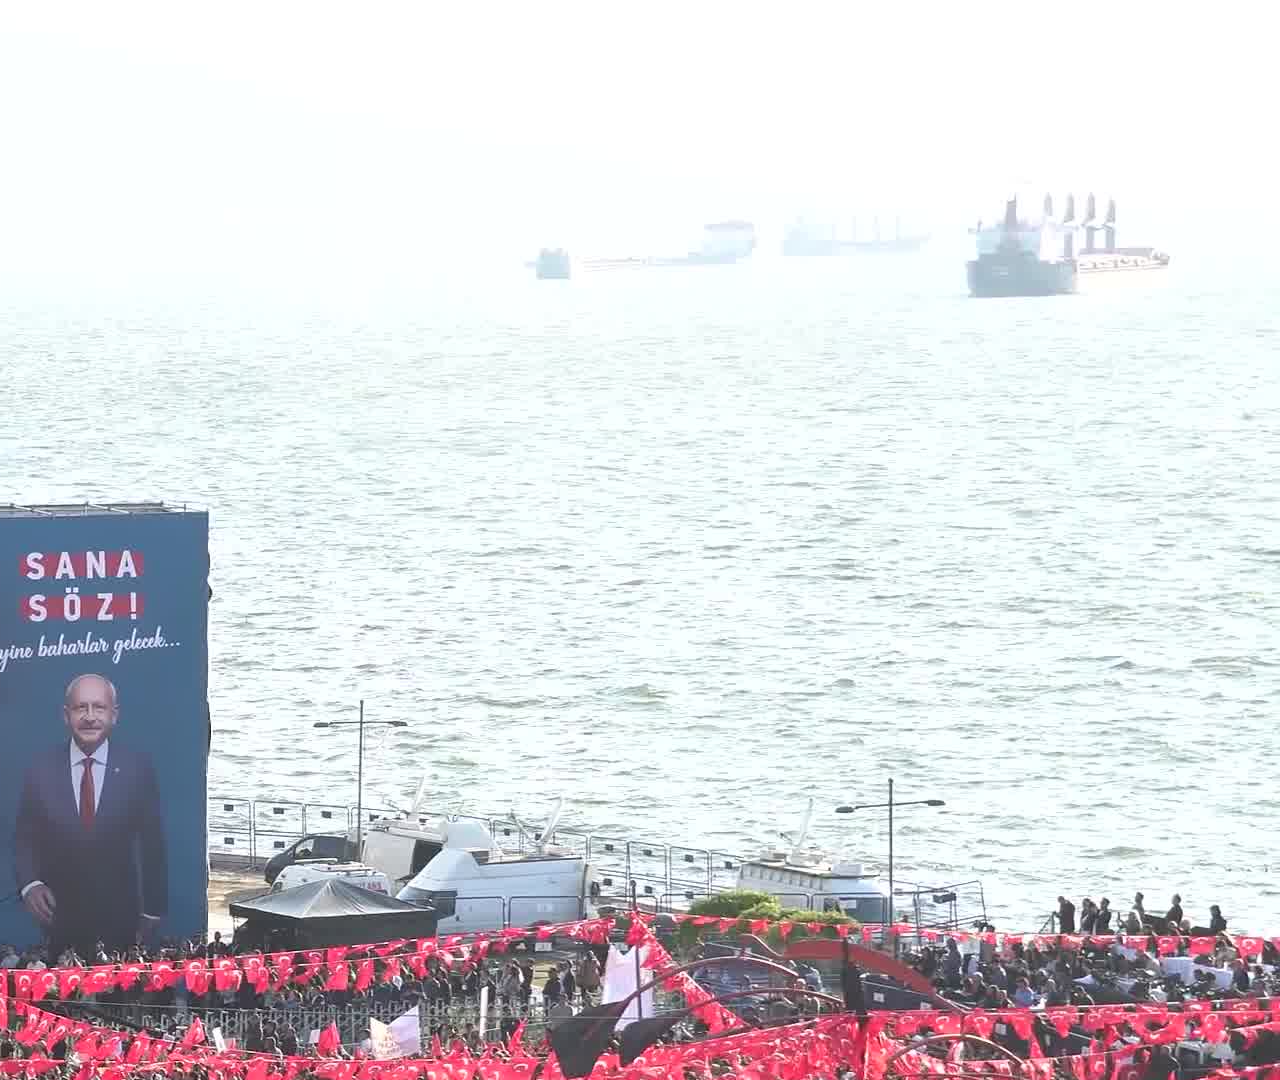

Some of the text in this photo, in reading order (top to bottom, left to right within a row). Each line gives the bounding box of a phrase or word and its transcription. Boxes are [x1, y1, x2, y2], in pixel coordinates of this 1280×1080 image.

[26, 550, 138, 580] SANA
[28, 587, 138, 622] SÖZ!
[37, 631, 111, 657] baharlar
[113, 625, 181, 664] gelecek...
